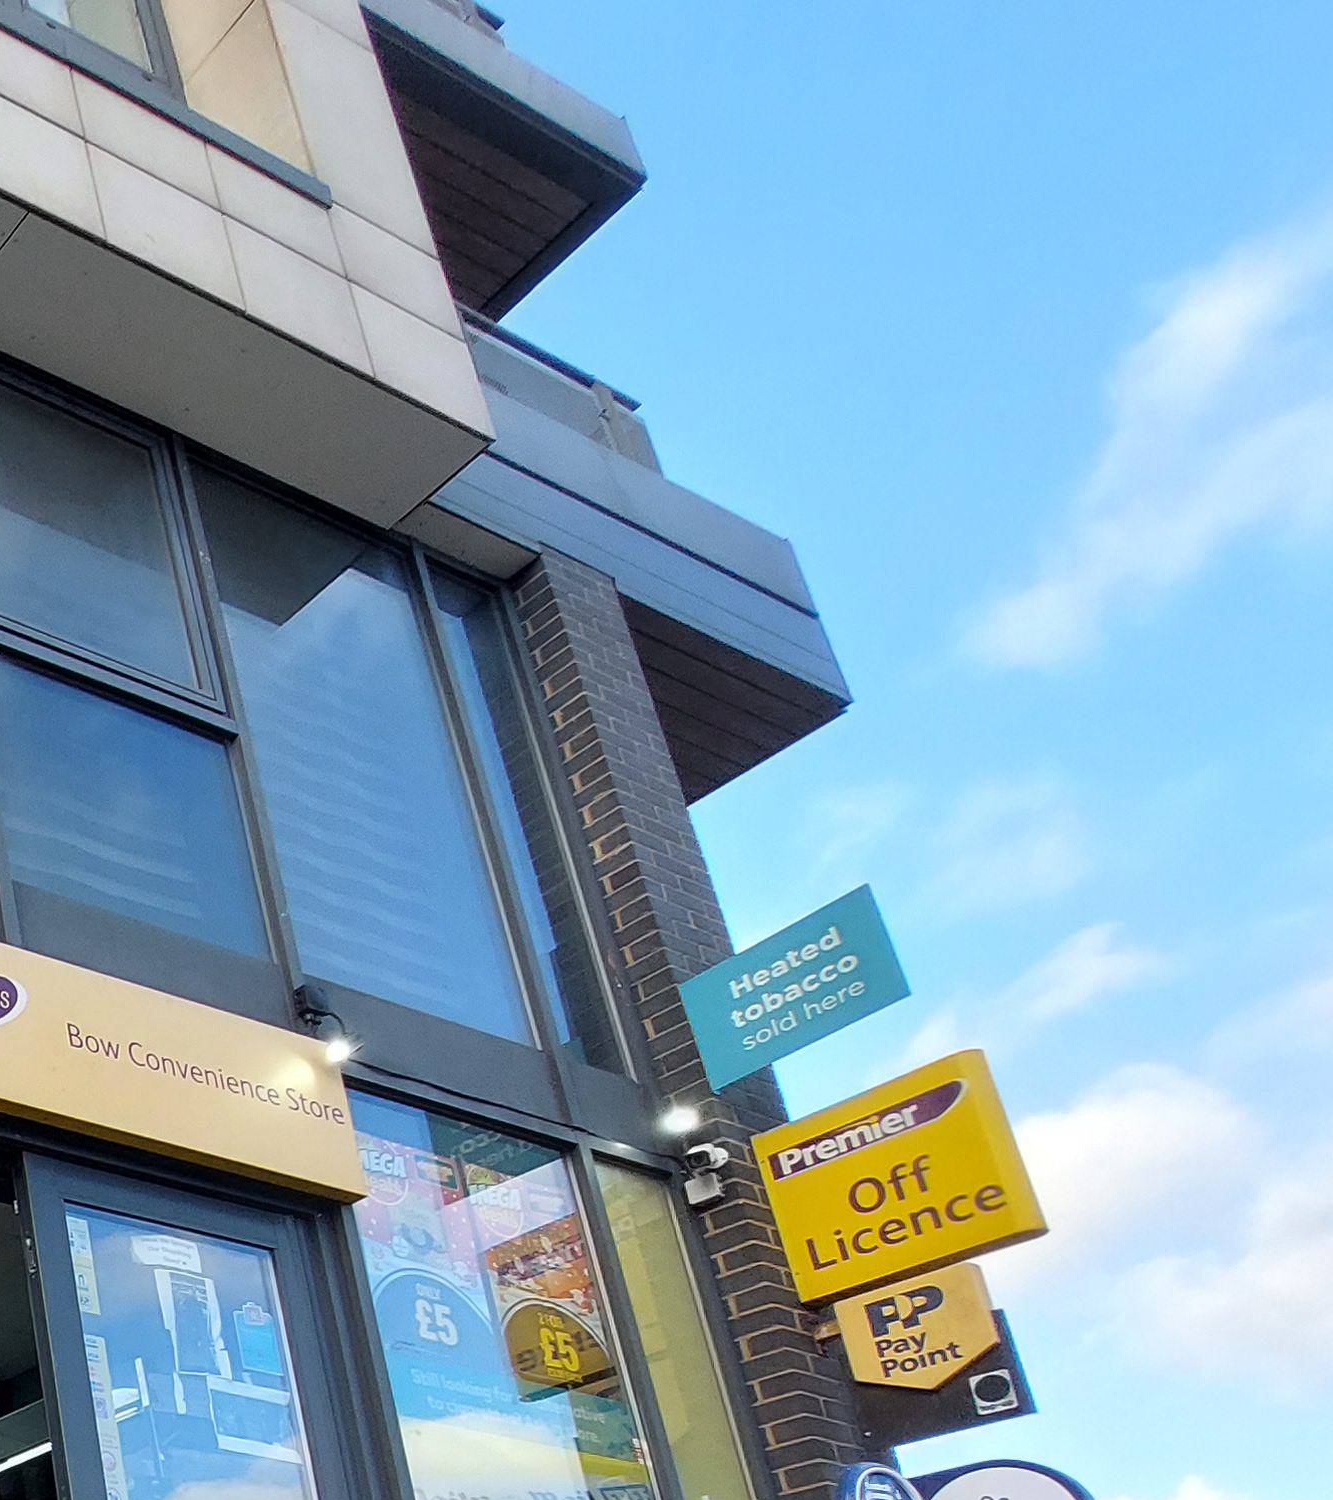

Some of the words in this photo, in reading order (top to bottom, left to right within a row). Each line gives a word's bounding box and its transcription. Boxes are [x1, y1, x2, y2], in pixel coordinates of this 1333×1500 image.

[728, 925, 843, 1000] Heated
[730, 951, 859, 1029] tobacco
[741, 1010, 799, 1052] sold
[804, 976, 867, 1026] here
[66, 1022, 121, 1061] Bow
[127, 1041, 281, 1107] Convenience
[284, 1086, 346, 1125] Store
[777, 1099, 921, 1176] Premier
[848, 1154, 932, 1214] Off
[805, 1182, 1009, 1271] Licence
[415, 1283, 441, 1299] ONLY
[415, 1299, 458, 1346] £5
[539, 1327, 580, 1373] £5
[874, 1330, 928, 1360] Pay
[880, 1339, 964, 1379] Point
